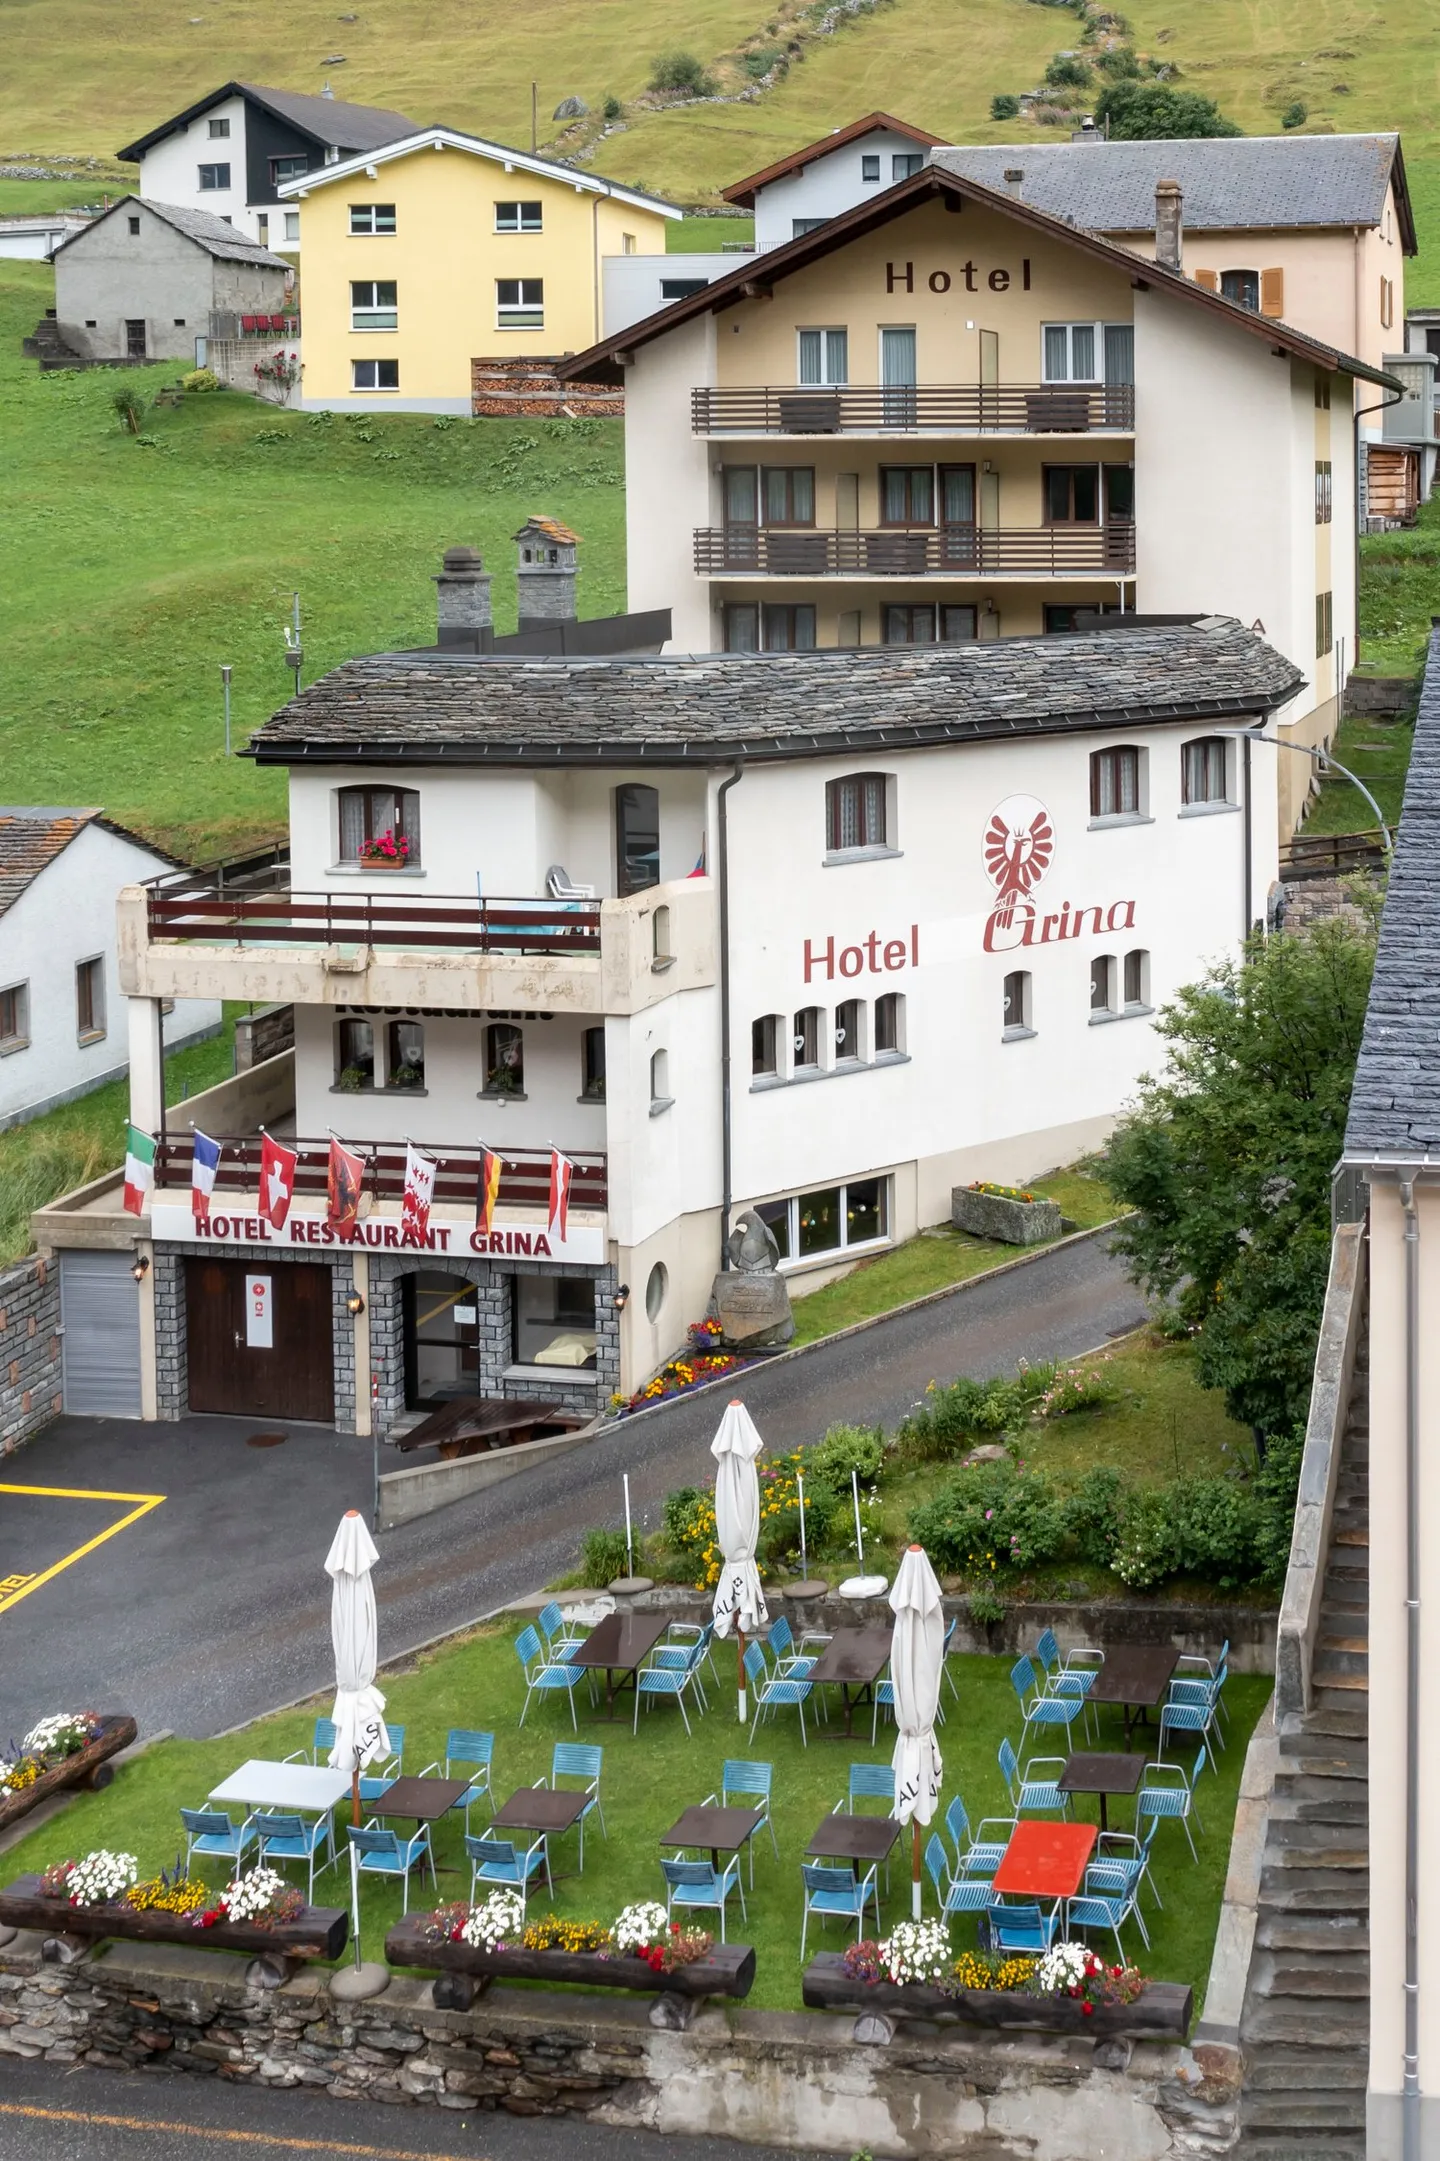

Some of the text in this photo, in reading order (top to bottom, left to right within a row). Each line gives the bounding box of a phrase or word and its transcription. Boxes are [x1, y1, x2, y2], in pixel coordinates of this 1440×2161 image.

[886, 258, 1031, 294] Hotel
[803, 900, 1136, 984] Hotel Grina
[195, 1216, 552, 1256] HOTEL RESAURANT GRINA
[0, 1572, 37, 1601] TEL
